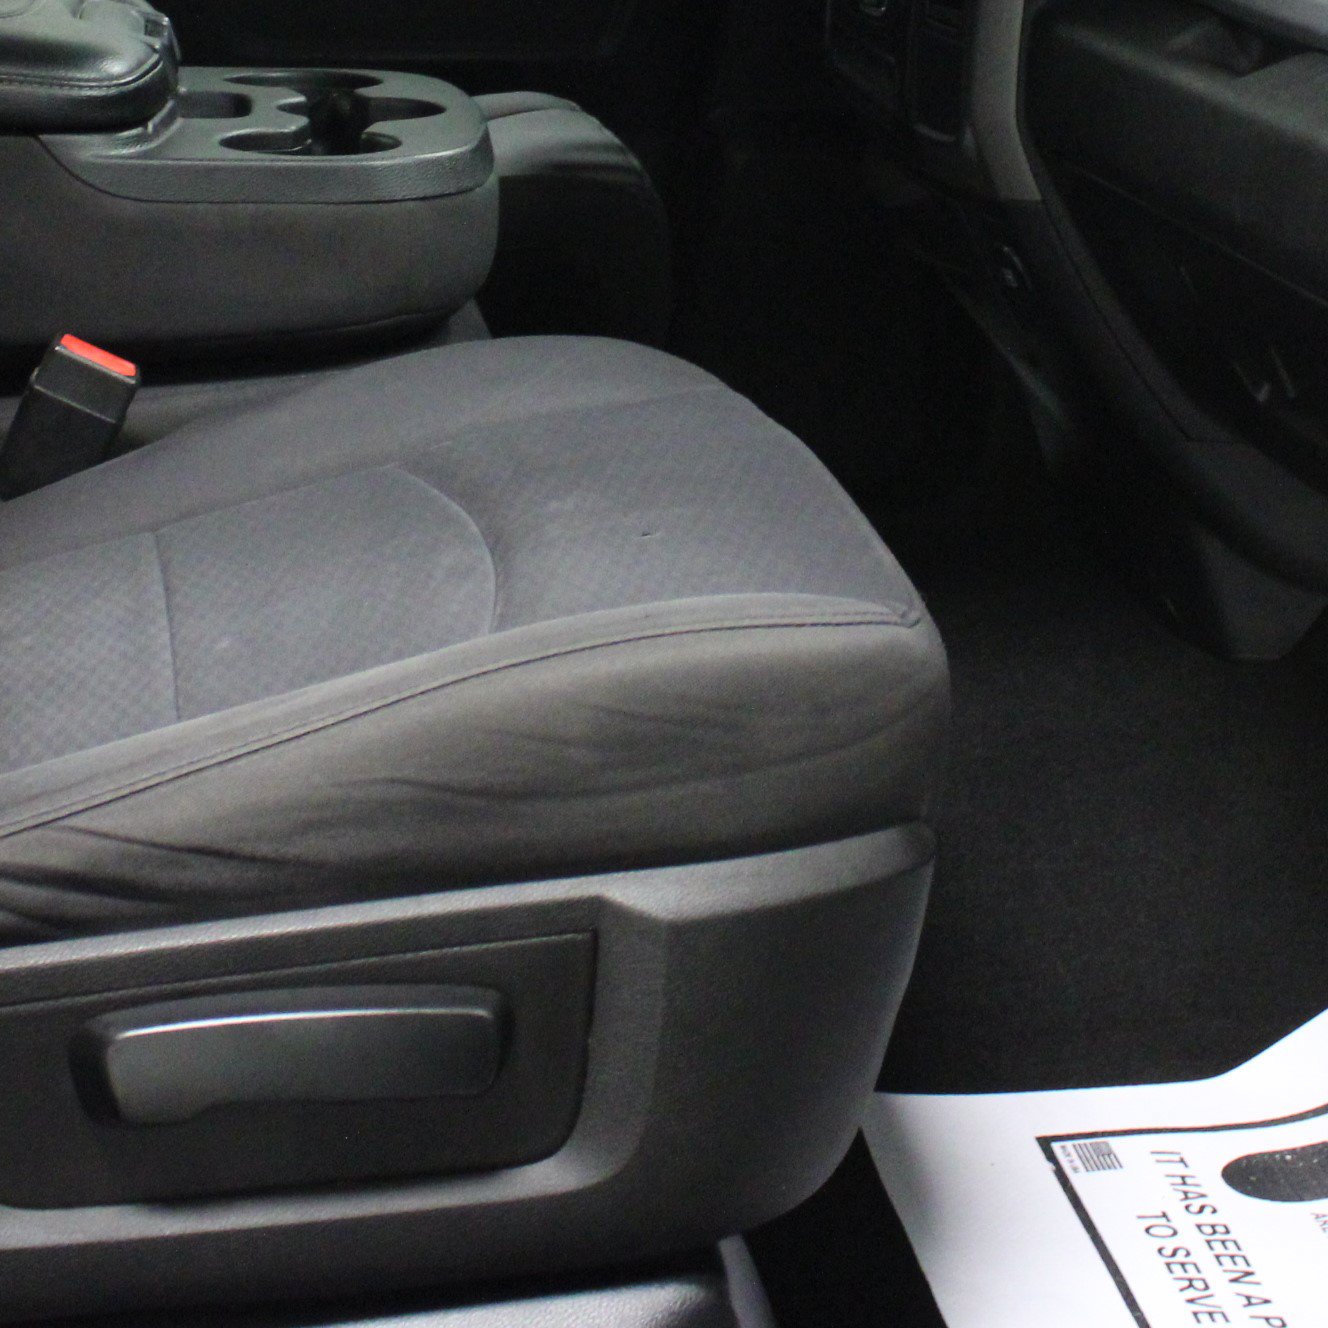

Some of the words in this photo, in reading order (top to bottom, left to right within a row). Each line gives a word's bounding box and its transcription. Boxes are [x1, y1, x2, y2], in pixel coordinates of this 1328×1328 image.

[1150, 1150, 1189, 1169] IT
[1165, 1174, 1217, 1215] HAS
[1136, 1211, 1178, 1238] TO
[1157, 1246, 1231, 1324] SERVE
[1195, 1223, 1261, 1285] BEEN
[1233, 1292, 1273, 1308] A
